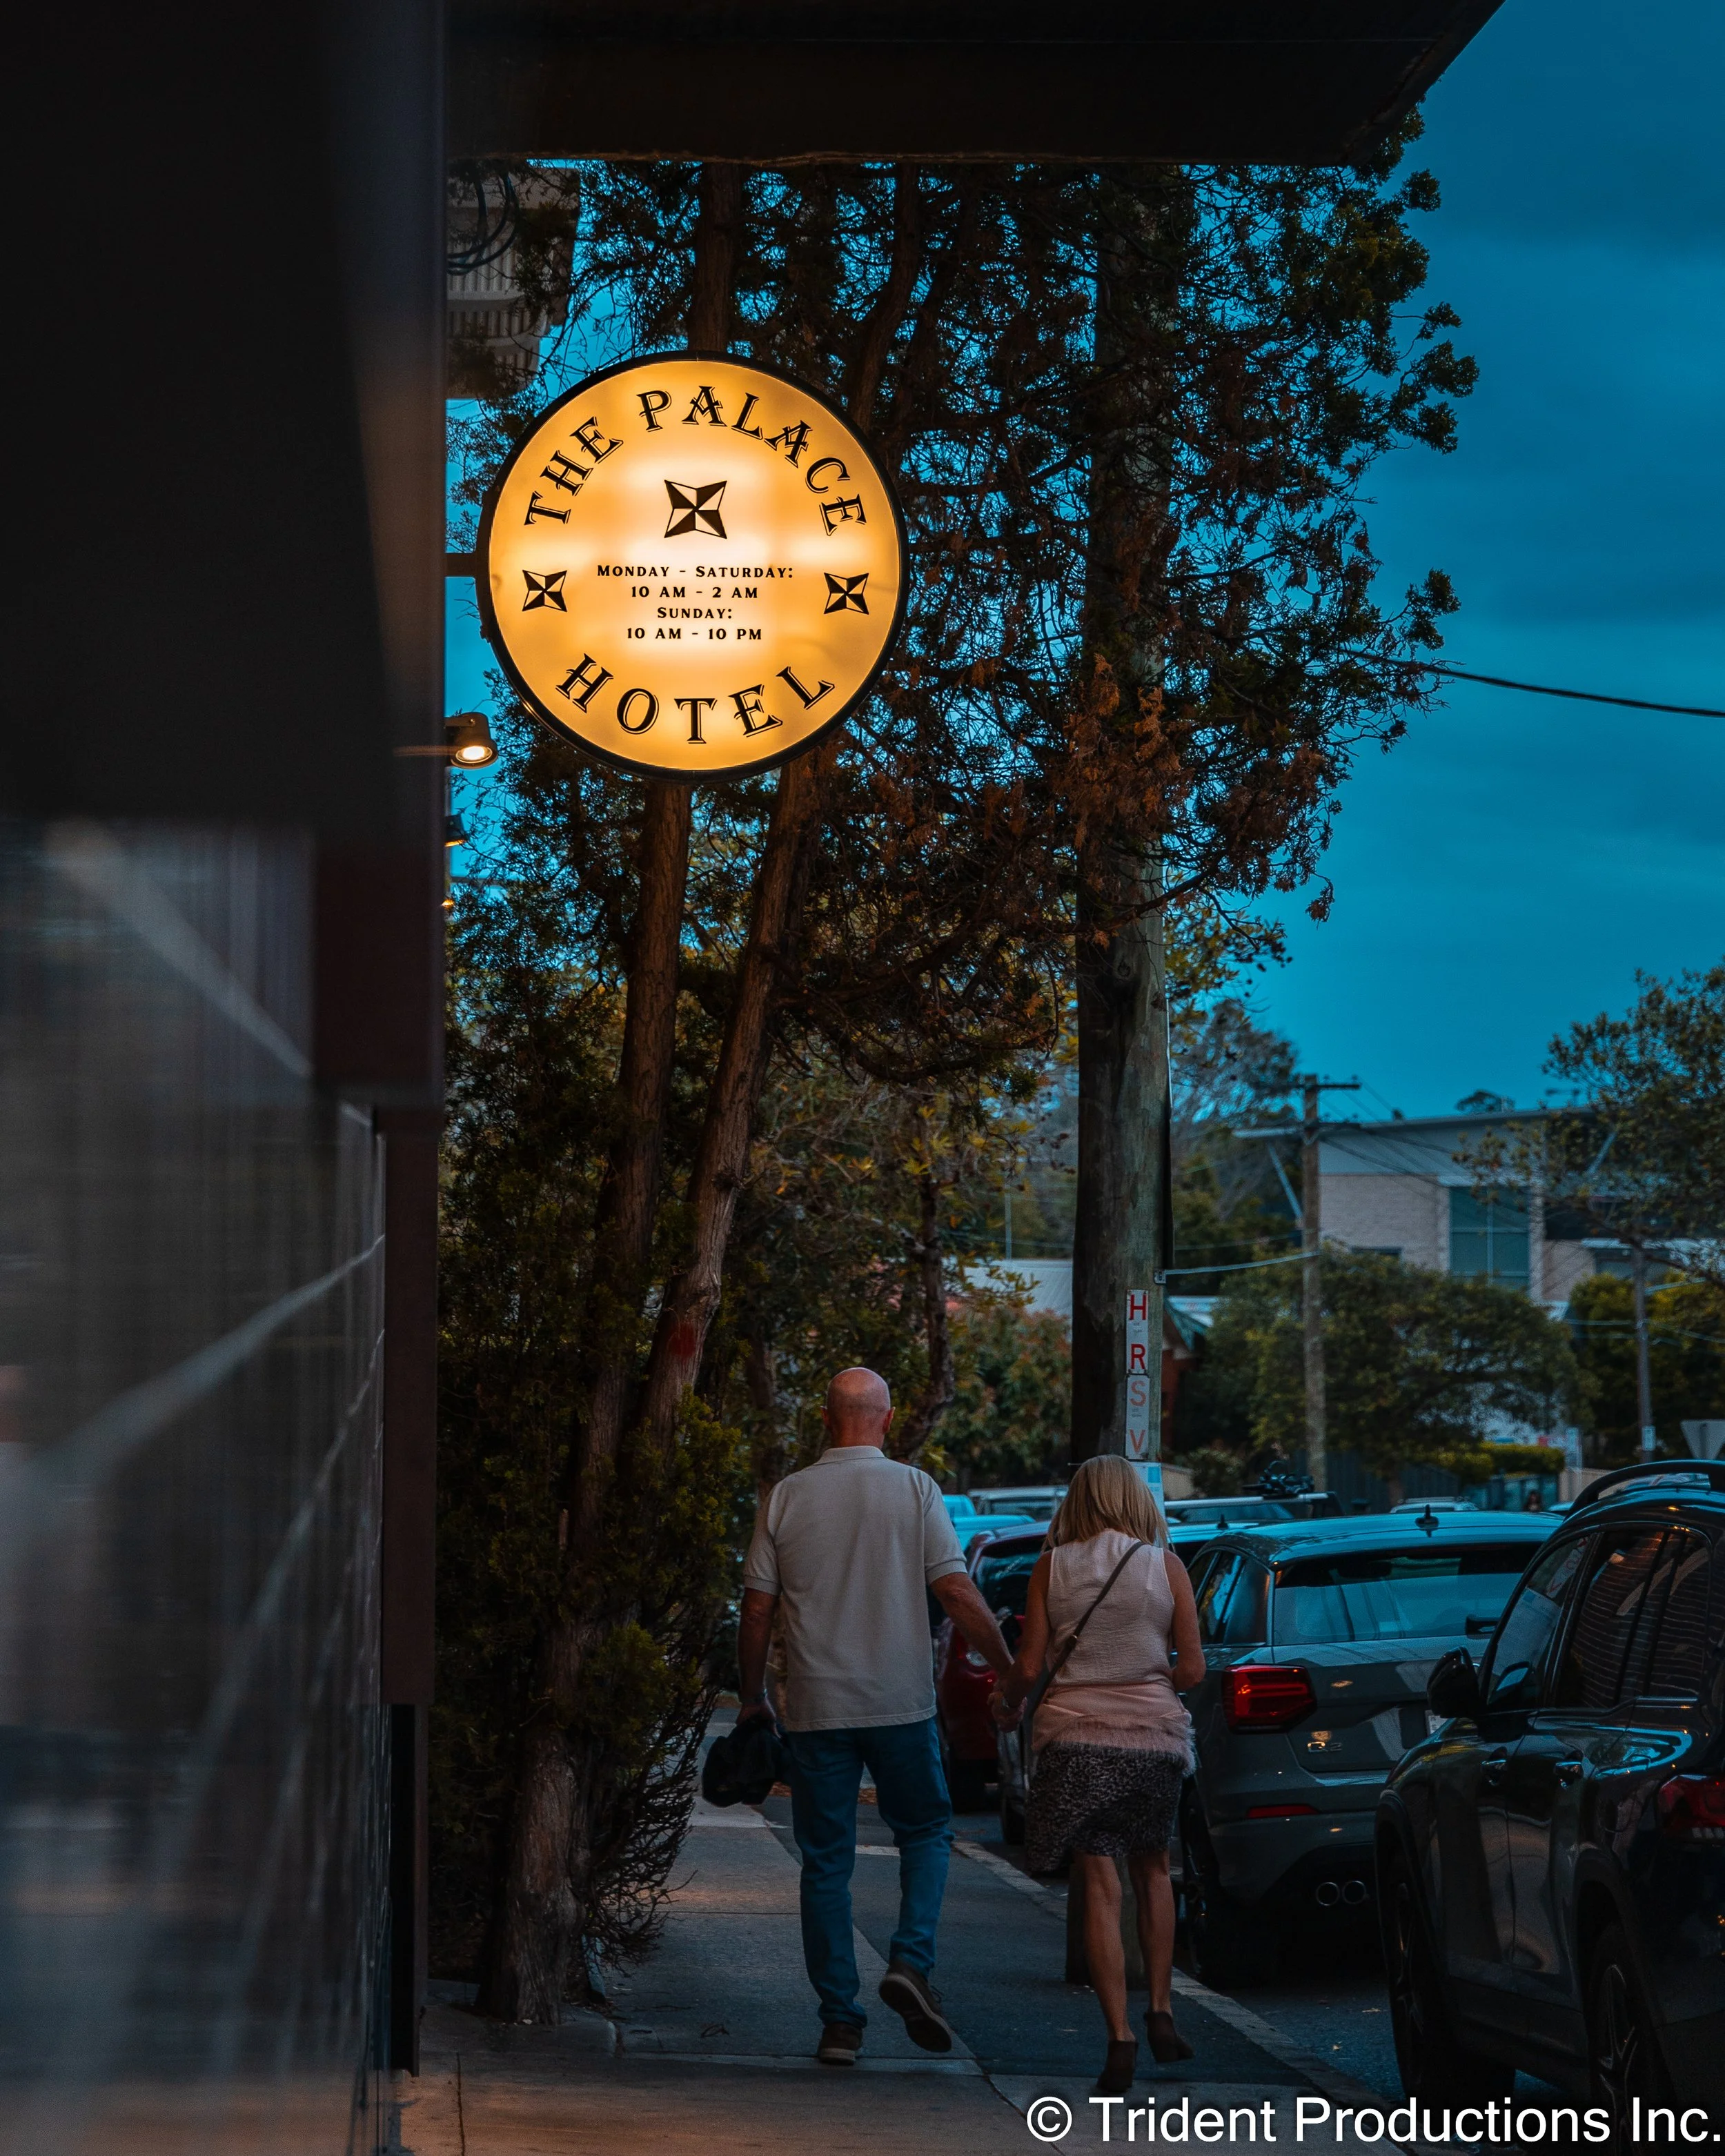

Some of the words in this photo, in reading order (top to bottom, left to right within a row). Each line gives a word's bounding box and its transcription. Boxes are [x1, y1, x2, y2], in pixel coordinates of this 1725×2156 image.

[524, 416, 624, 526] THE
[636, 386, 867, 536] PALACE
[597, 565, 669, 577] MONDAY
[696, 566, 793, 578] SATURDAY:
[631, 586, 649, 597] 10
[659, 586, 685, 598] AM
[712, 586, 722, 598] 2
[731, 586, 758, 598] AM
[657, 606, 732, 619] SUNDAY:
[627, 627, 645, 639] 10
[655, 627, 681, 640] AM
[709, 628, 727, 640] 10
[737, 629, 761, 640] PM
[555, 653, 834, 744] HOTEL
[1307, 1739, 1342, 1750] Q2
